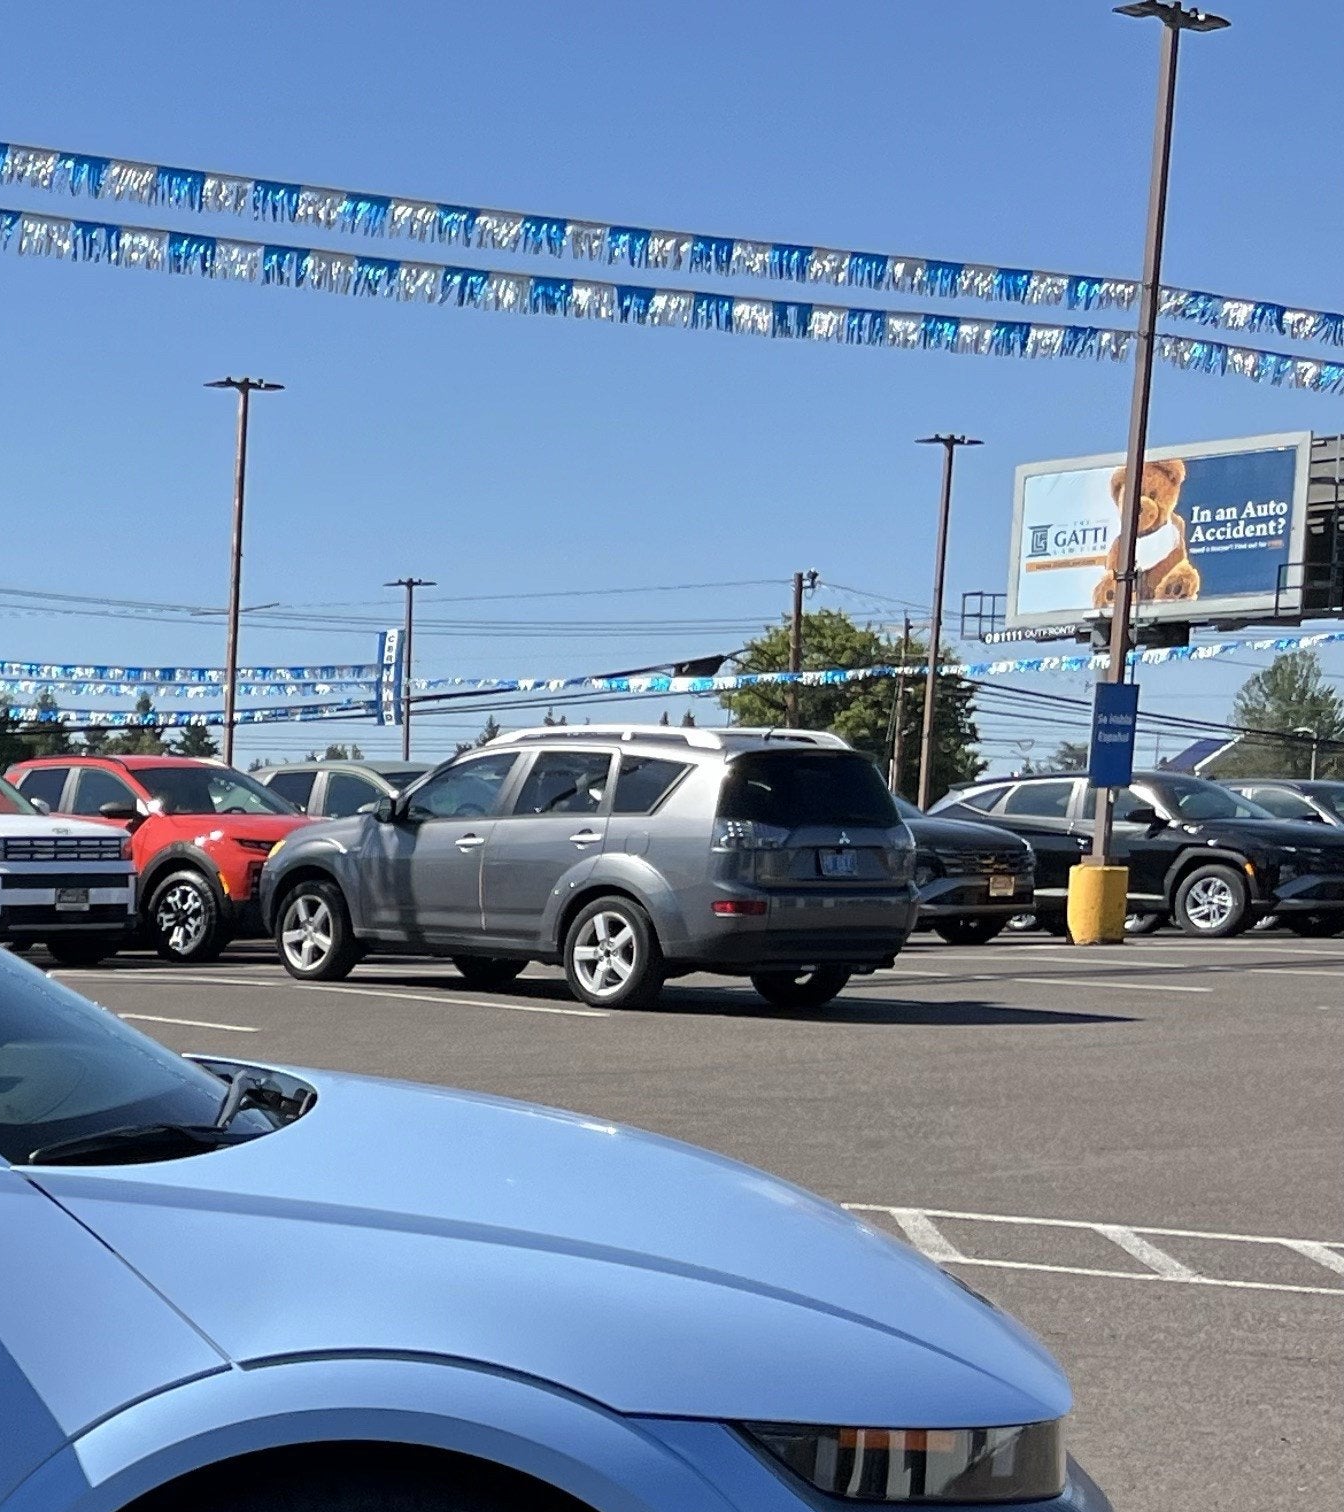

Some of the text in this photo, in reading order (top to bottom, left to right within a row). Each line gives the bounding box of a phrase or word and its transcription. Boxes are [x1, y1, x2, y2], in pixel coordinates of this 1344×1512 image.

[1191, 500, 1288, 523] In an Auto
[1054, 525, 1108, 548] GATTI
[1190, 517, 1286, 542] Accident?
